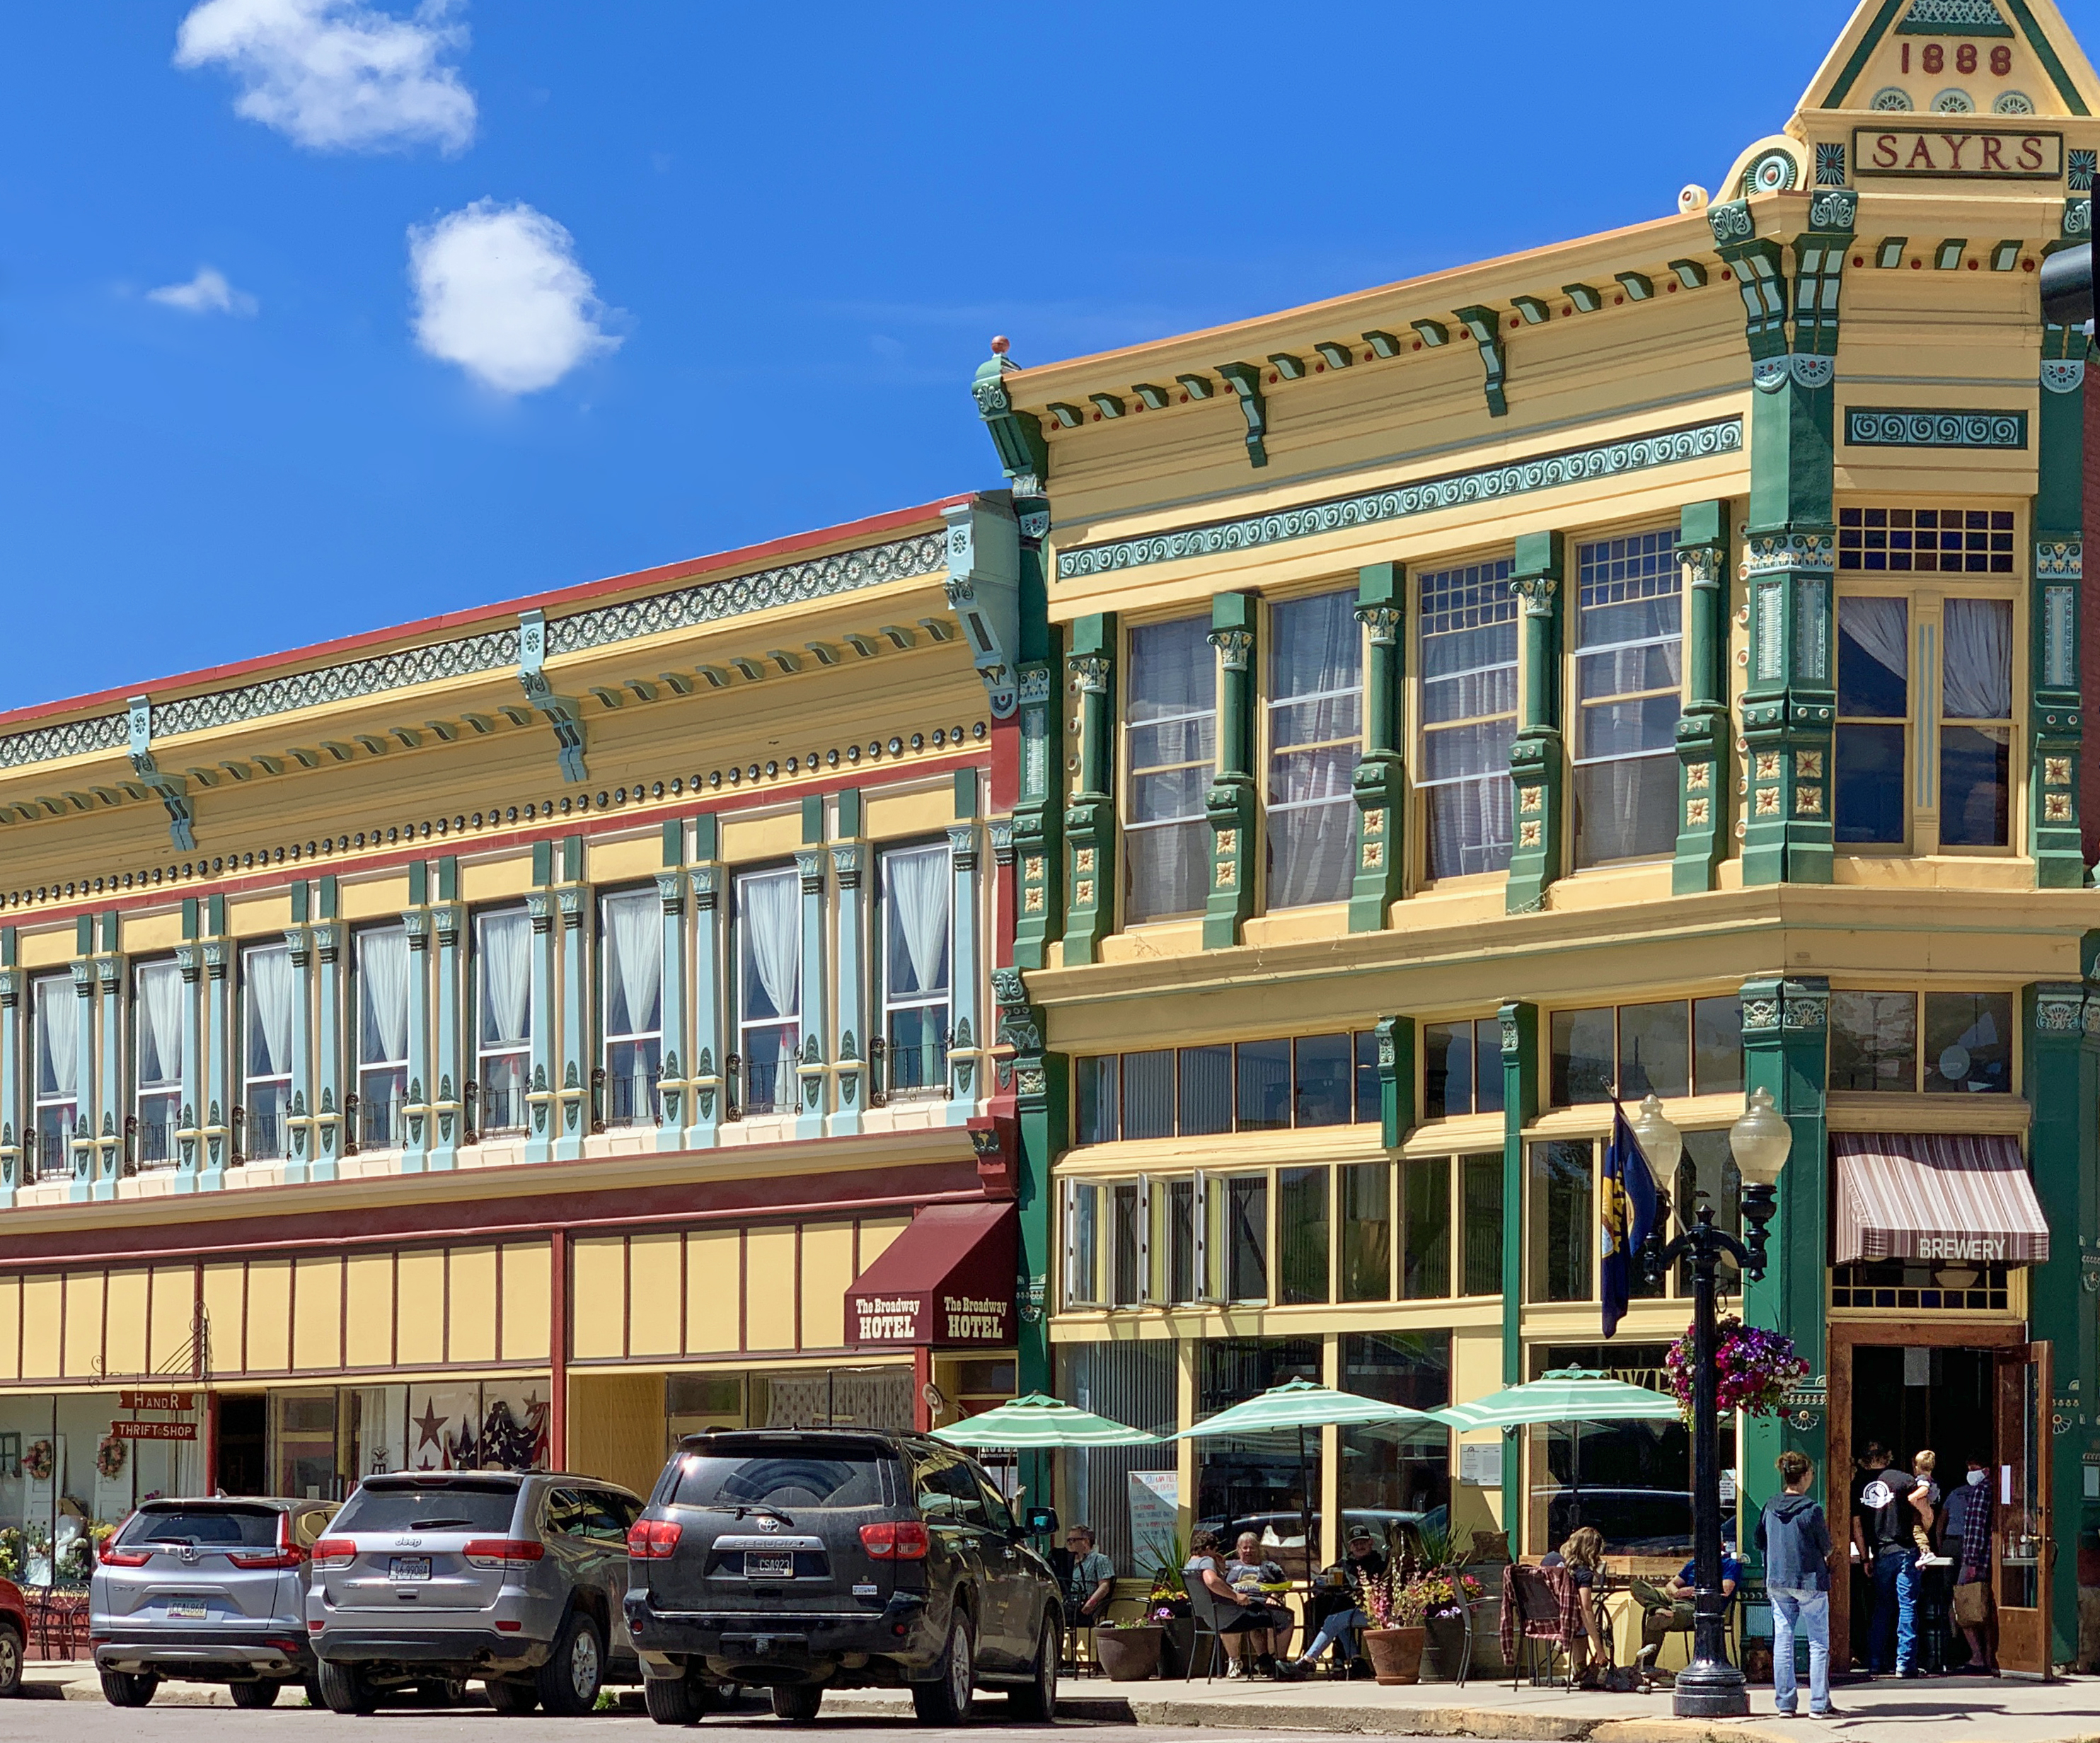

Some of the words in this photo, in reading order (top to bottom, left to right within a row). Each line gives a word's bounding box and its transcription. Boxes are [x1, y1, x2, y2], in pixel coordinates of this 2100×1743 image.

[1901, 42, 2012, 76] 1888
[1872, 134, 2043, 170] SAYRS
[1920, 1237, 2006, 1261] BREWERY
[856, 1298, 873, 1314] The
[875, 1297, 920, 1315] Broadway
[944, 1296, 962, 1311] The
[962, 1297, 1008, 1317] Broadway
[859, 1315, 915, 1339] HOTEL
[947, 1314, 1003, 1339] HOTEL
[119, 1424, 158, 1435] THRIFT
[163, 1425, 192, 1437] SHOP
[395, 1536, 422, 1548] Jeep
